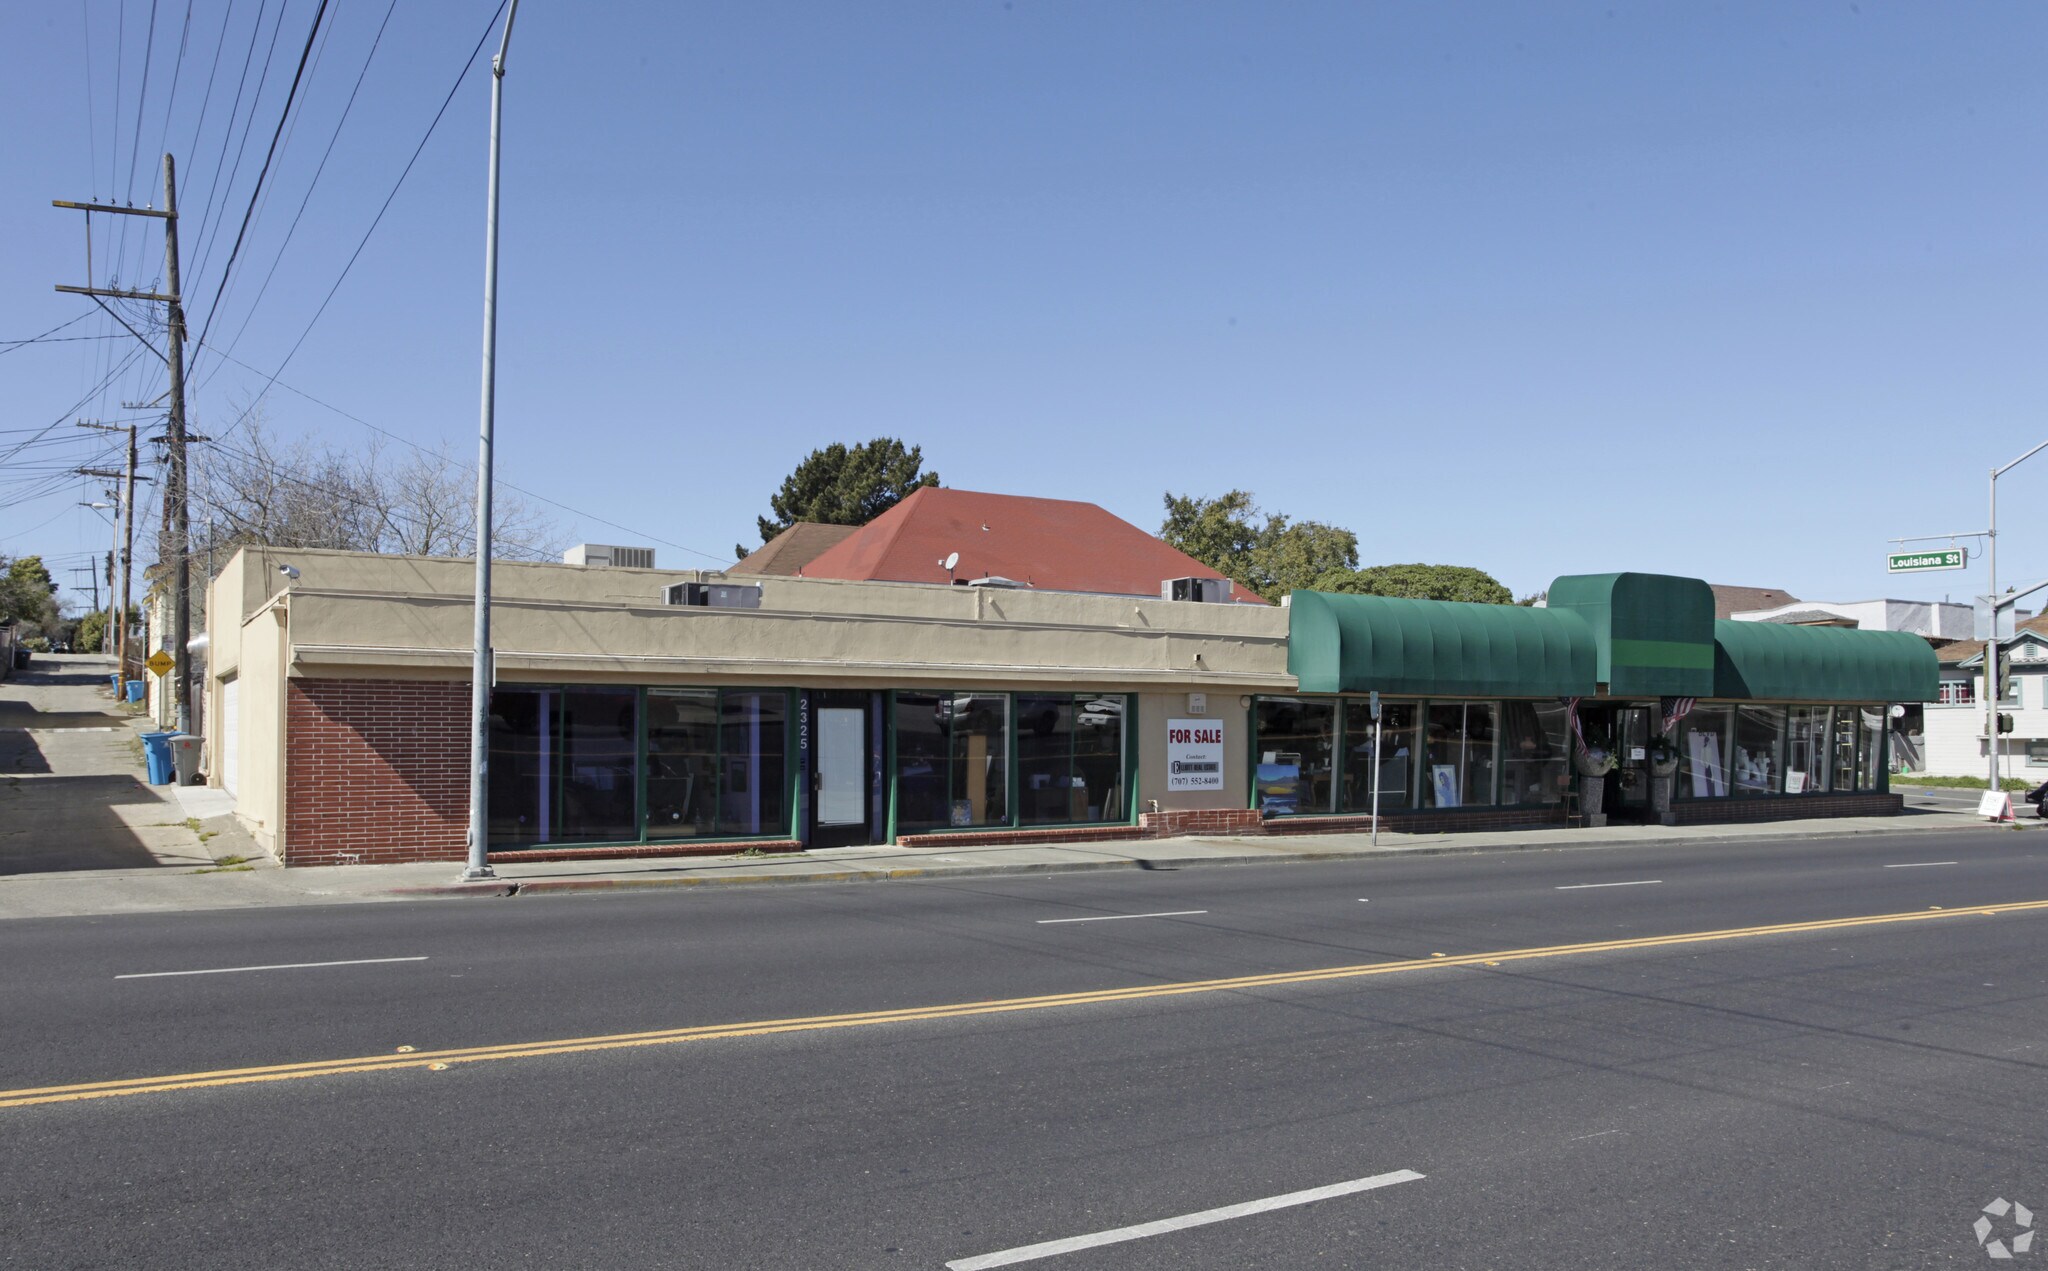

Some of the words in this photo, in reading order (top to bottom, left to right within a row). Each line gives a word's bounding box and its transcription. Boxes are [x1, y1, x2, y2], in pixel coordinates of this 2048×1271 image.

[1890, 556, 1942, 568] Louisiana
[1945, 554, 1959, 564] St
[800, 699, 808, 749] 2325
[1169, 729, 1191, 744] FOR
[1194, 729, 1222, 744] SALE
[1171, 777, 1188, 786] (707)
[1190, 777, 1219, 785] 552-8400
